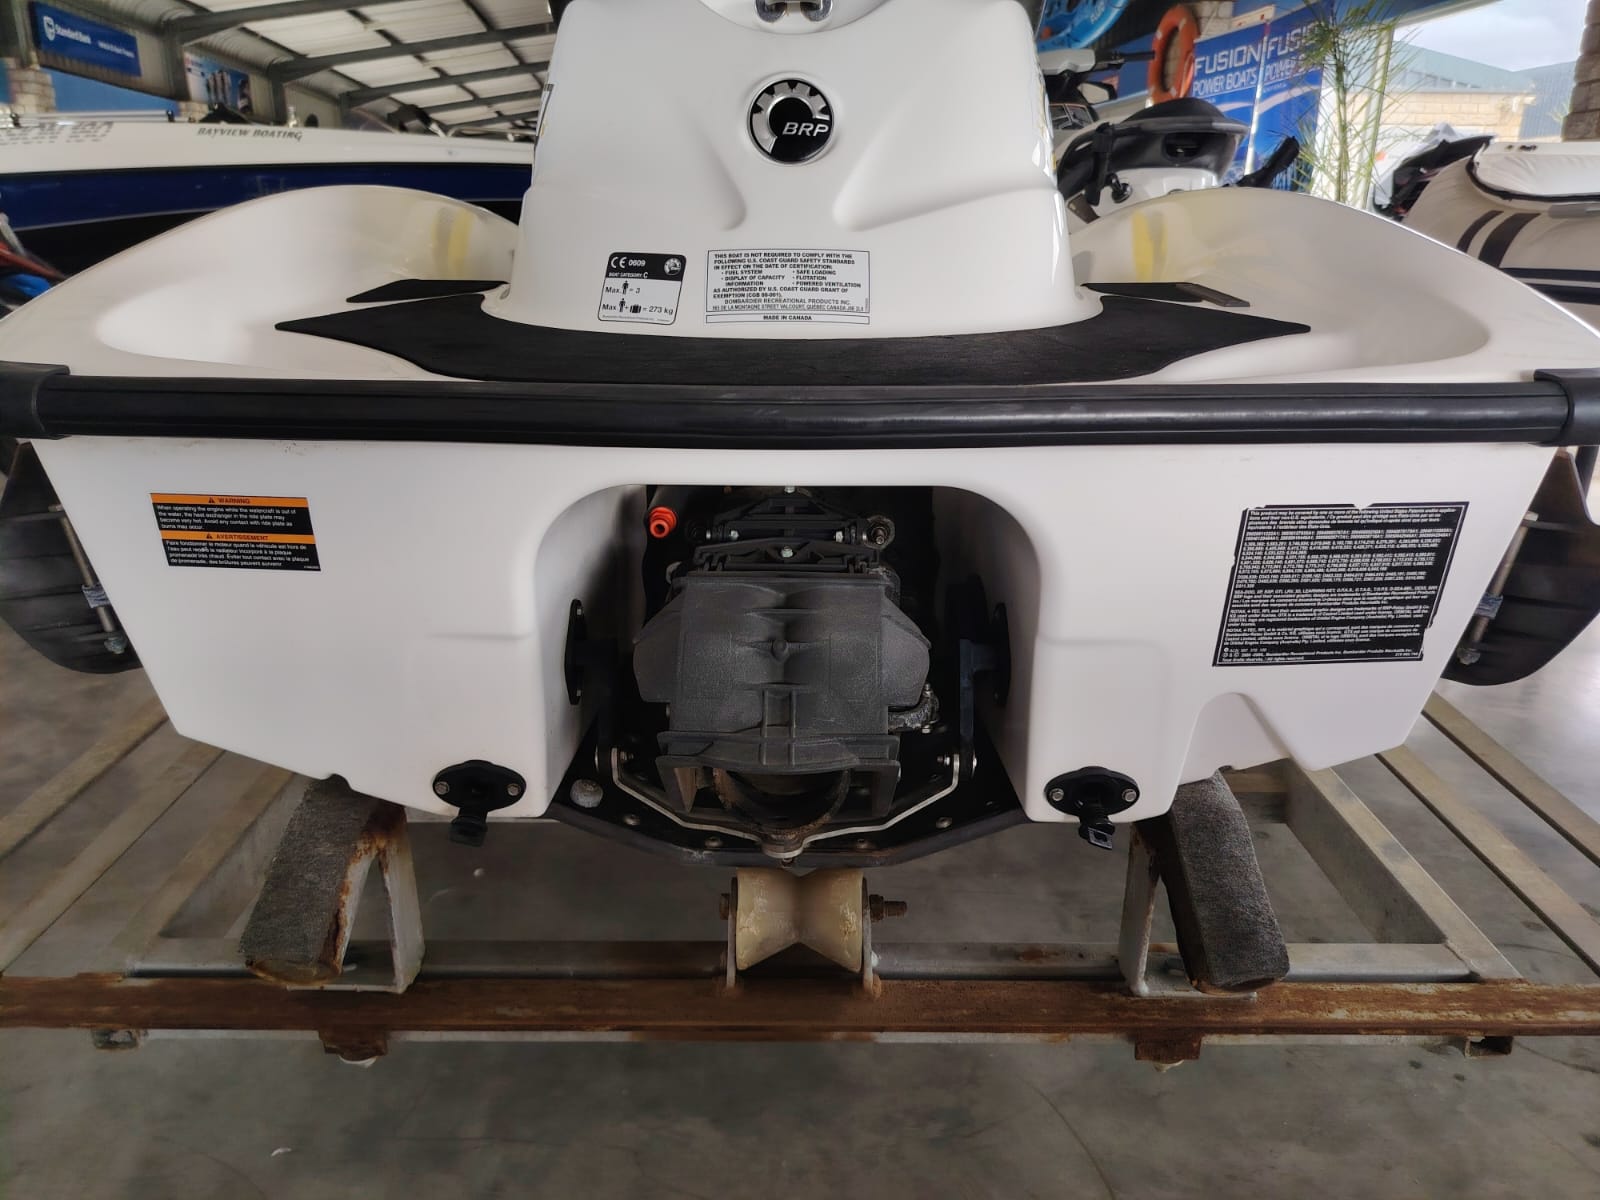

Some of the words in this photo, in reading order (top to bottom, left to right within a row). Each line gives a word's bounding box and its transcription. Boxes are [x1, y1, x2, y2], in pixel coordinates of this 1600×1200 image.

[1195, 43, 1261, 76] FUSION
[1193, 74, 1225, 96] POWER
[1226, 67, 1257, 89] BOATS
[198, 128, 249, 139] BAYVIEW
[253, 129, 303, 142] BOATING
[782, 122, 829, 136] BRP
[664, 307, 673, 315] kg
